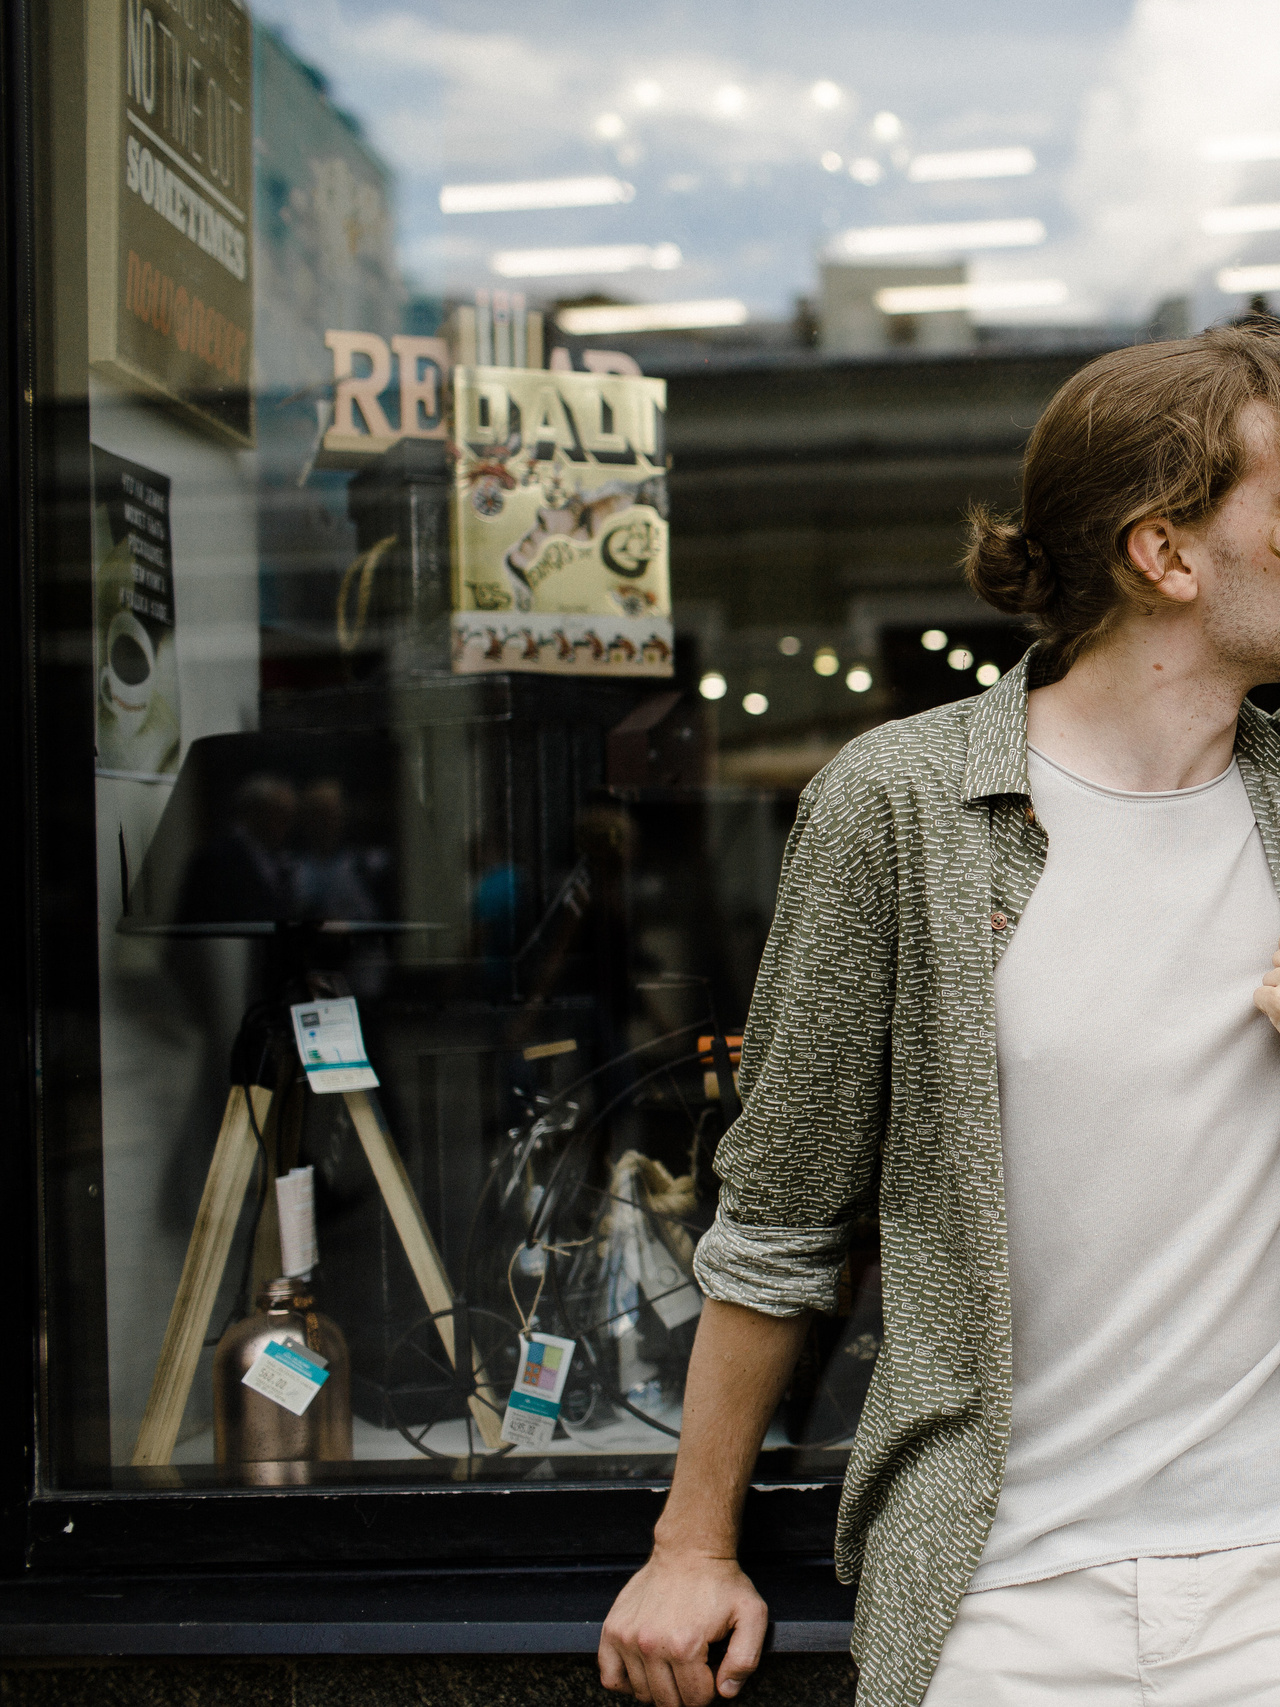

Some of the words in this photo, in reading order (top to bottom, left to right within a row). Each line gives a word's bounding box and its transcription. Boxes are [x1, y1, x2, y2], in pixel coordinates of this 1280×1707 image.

[127, 0, 156, 115] NO
[158, 20, 204, 164] TIME
[125, 133, 248, 283] SOMETIMES
